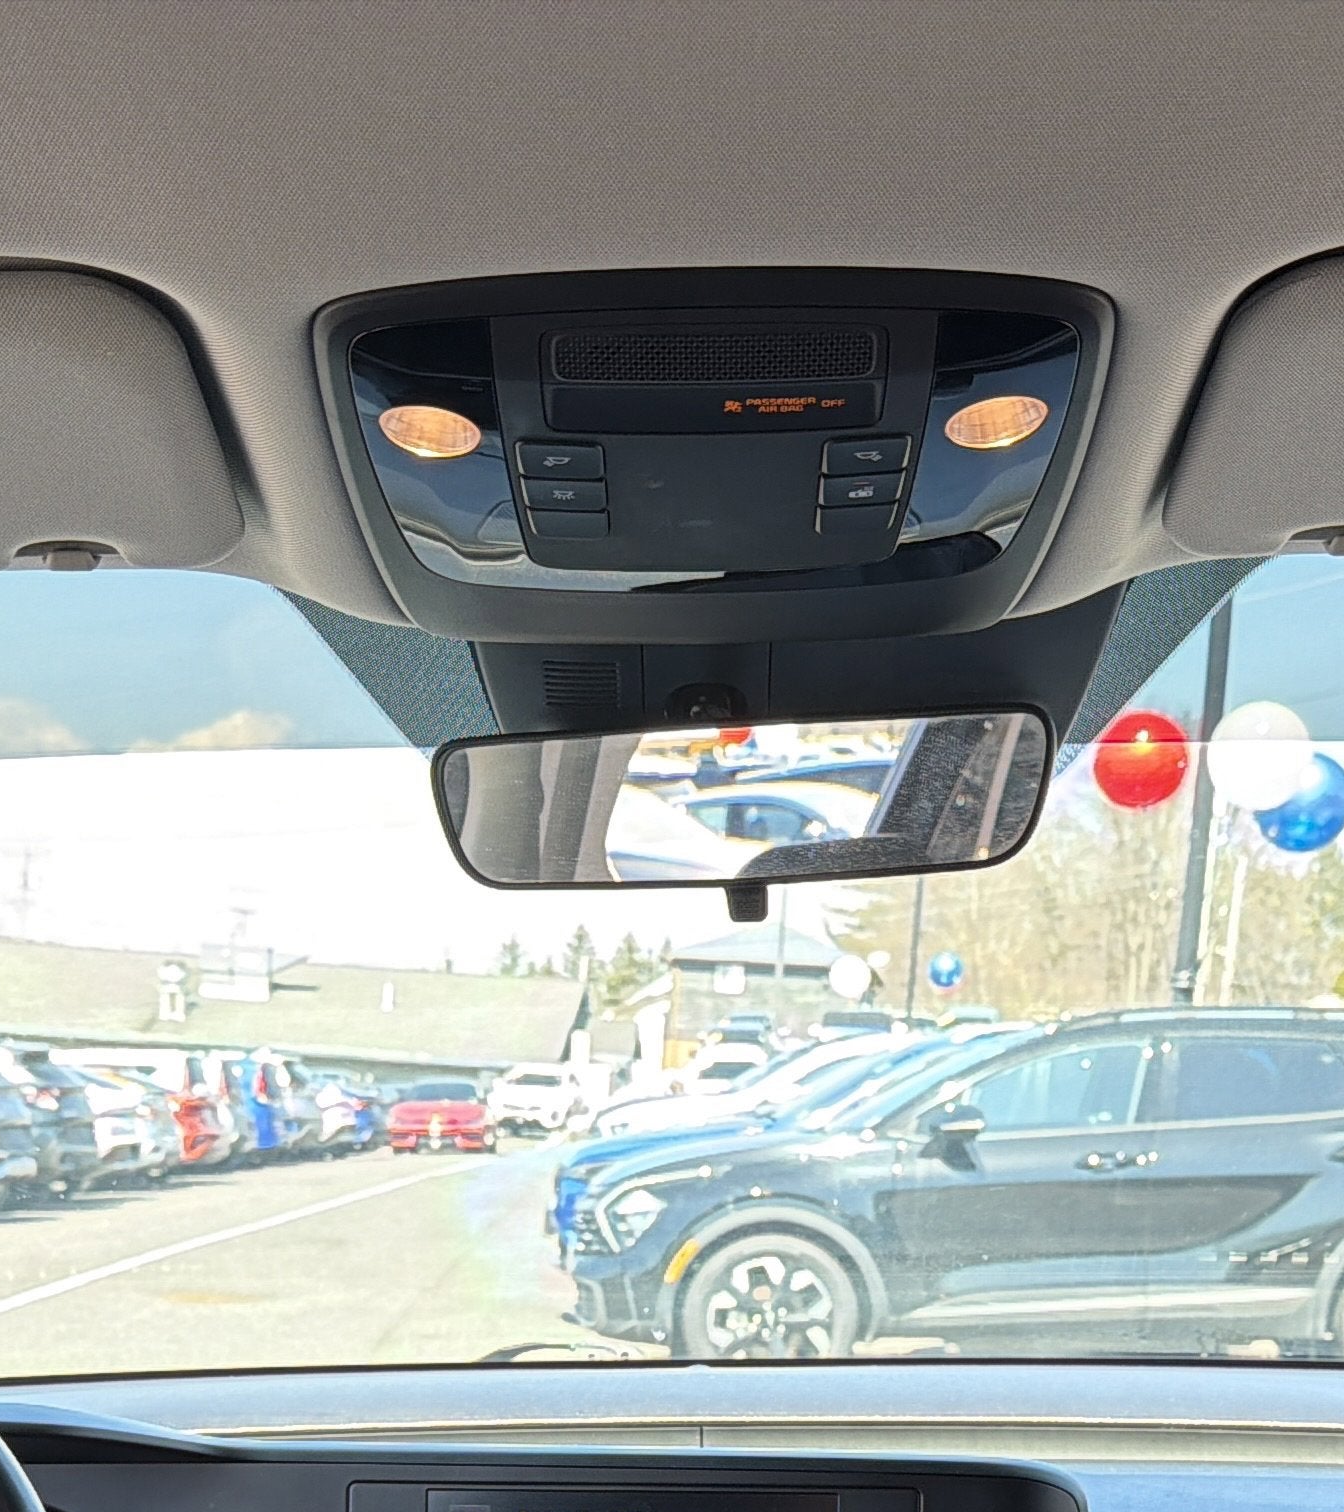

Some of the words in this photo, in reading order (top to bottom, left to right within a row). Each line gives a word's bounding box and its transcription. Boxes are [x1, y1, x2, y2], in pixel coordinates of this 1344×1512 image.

[745, 396, 816, 406] PASSENGER
[821, 399, 846, 408] OFF
[758, 405, 777, 413] AIR
[779, 404, 804, 413] BAG
